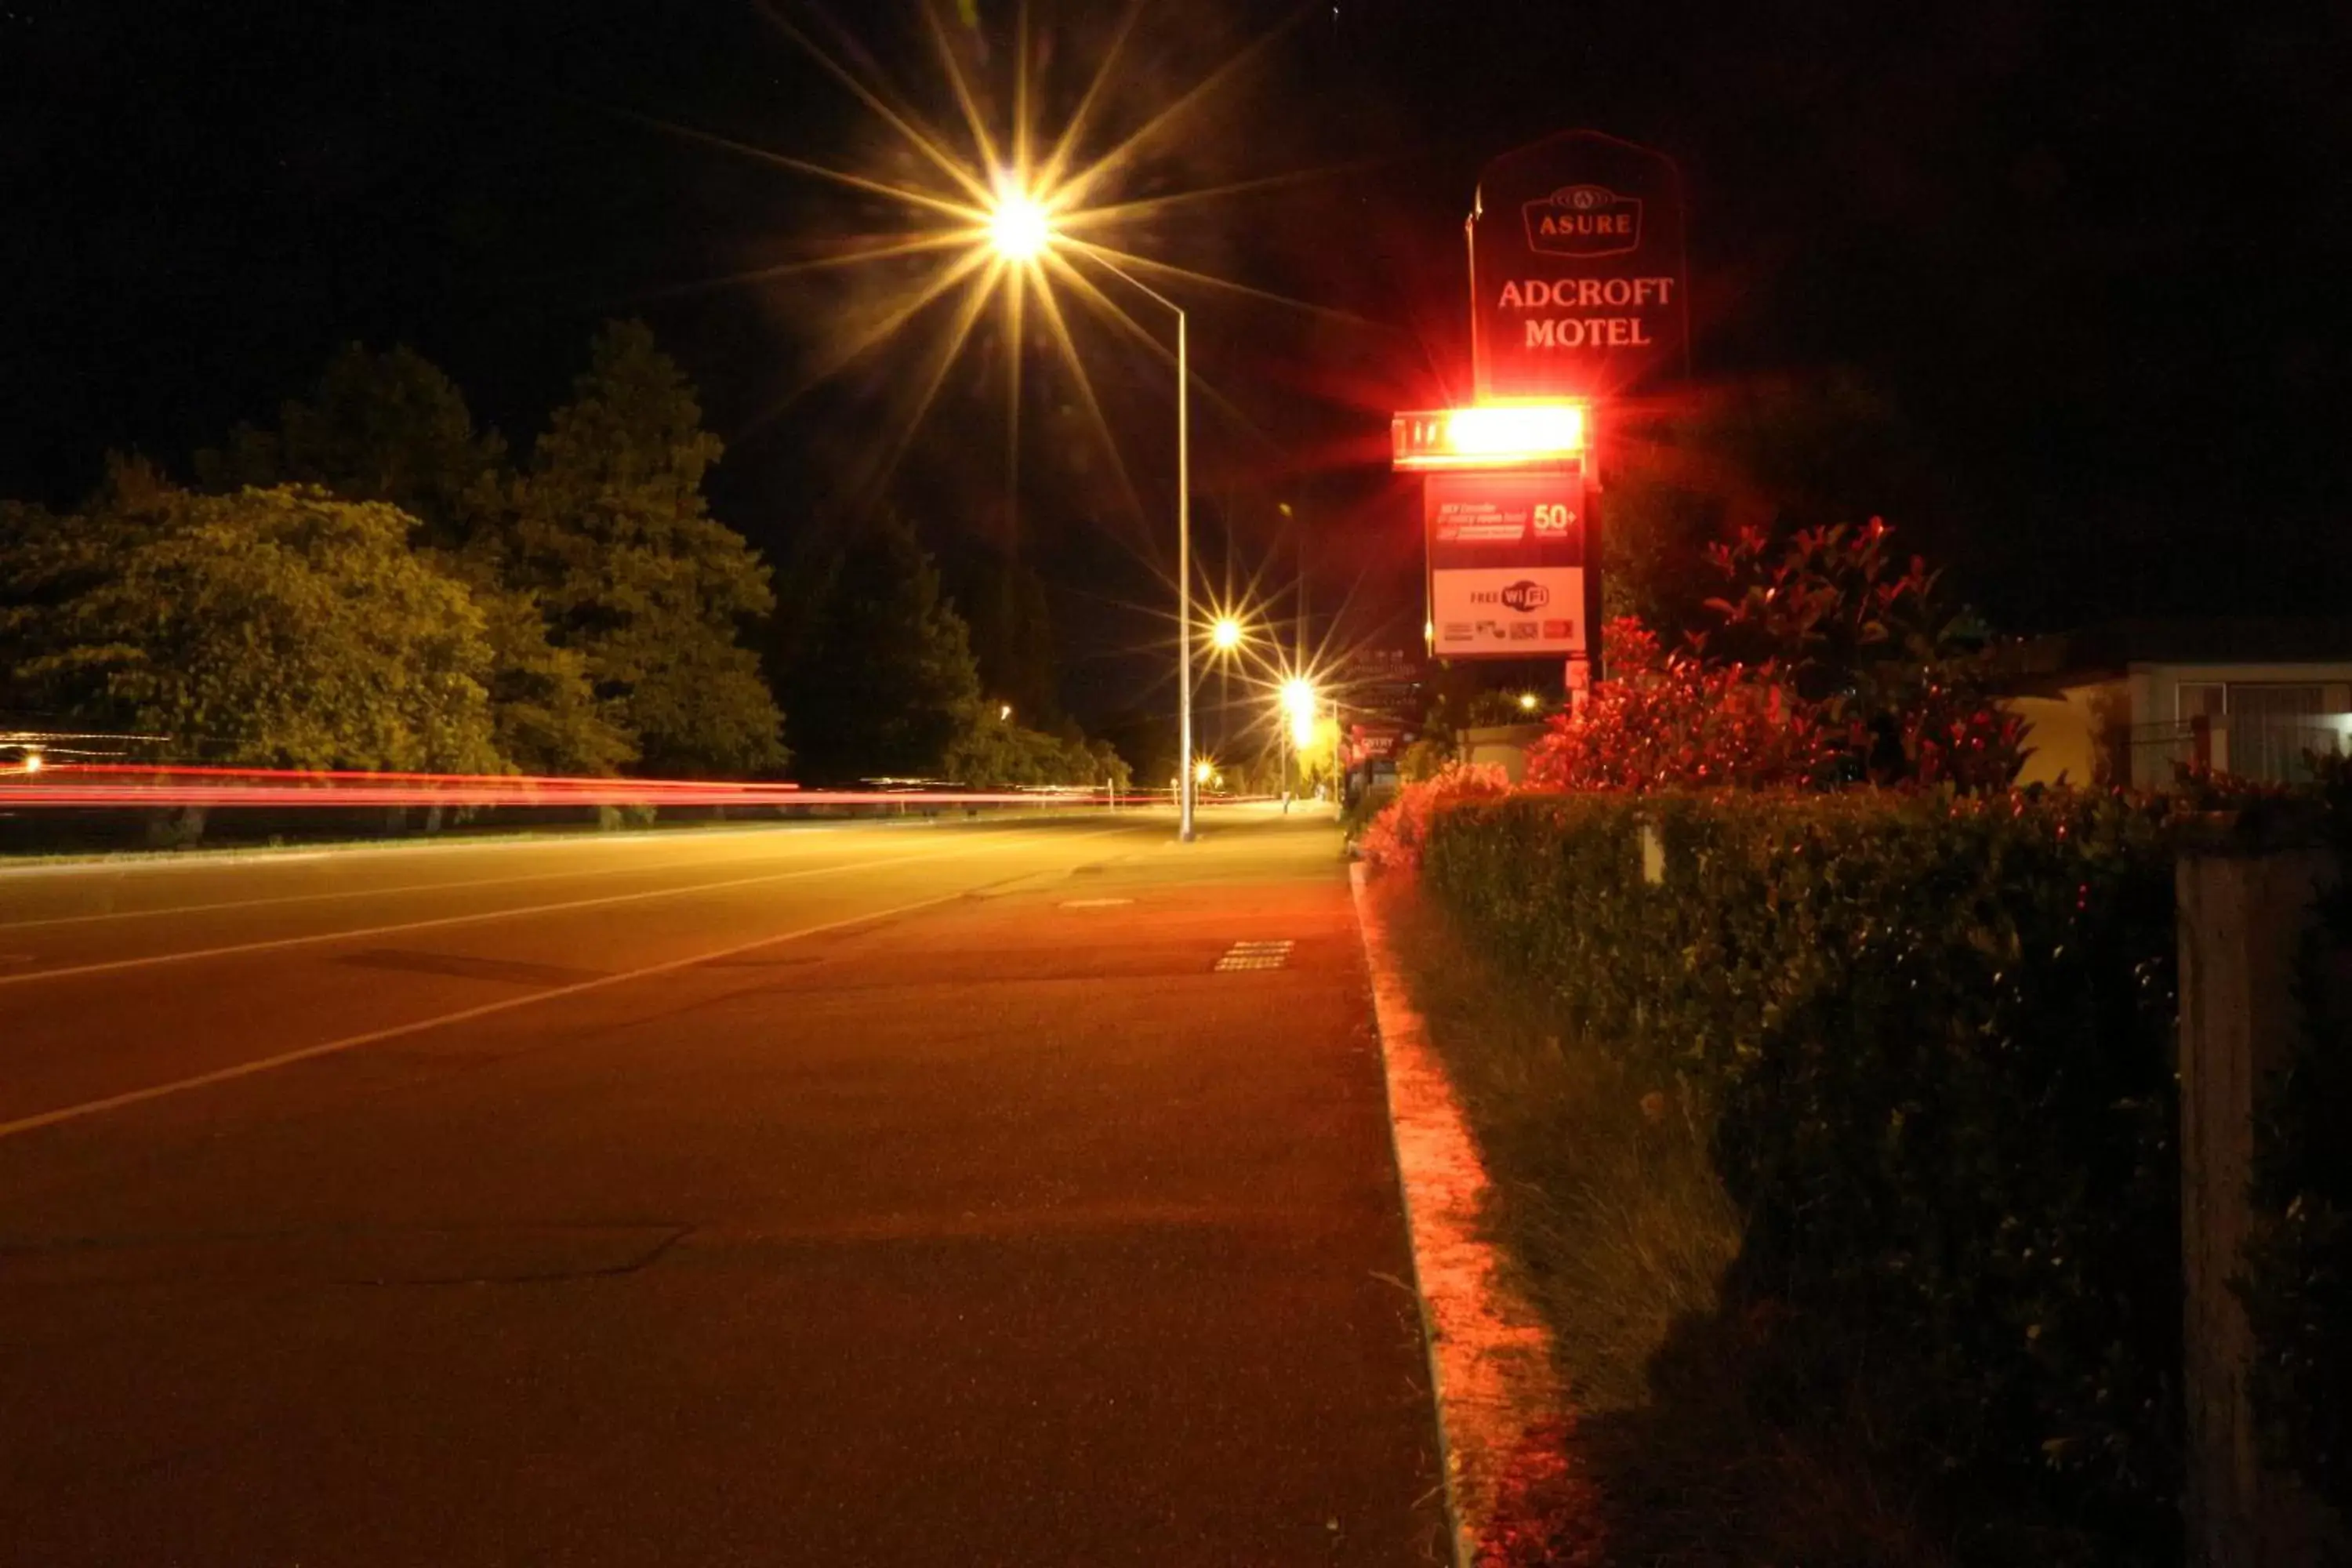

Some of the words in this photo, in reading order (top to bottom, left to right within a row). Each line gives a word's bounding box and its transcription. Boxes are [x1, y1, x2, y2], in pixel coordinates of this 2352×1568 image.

[1539, 214, 1632, 235] ASURE
[1497, 277, 1675, 308] ADCROFT
[1525, 318, 1651, 347] MOTEL
[1471, 592, 1499, 604] FREE
